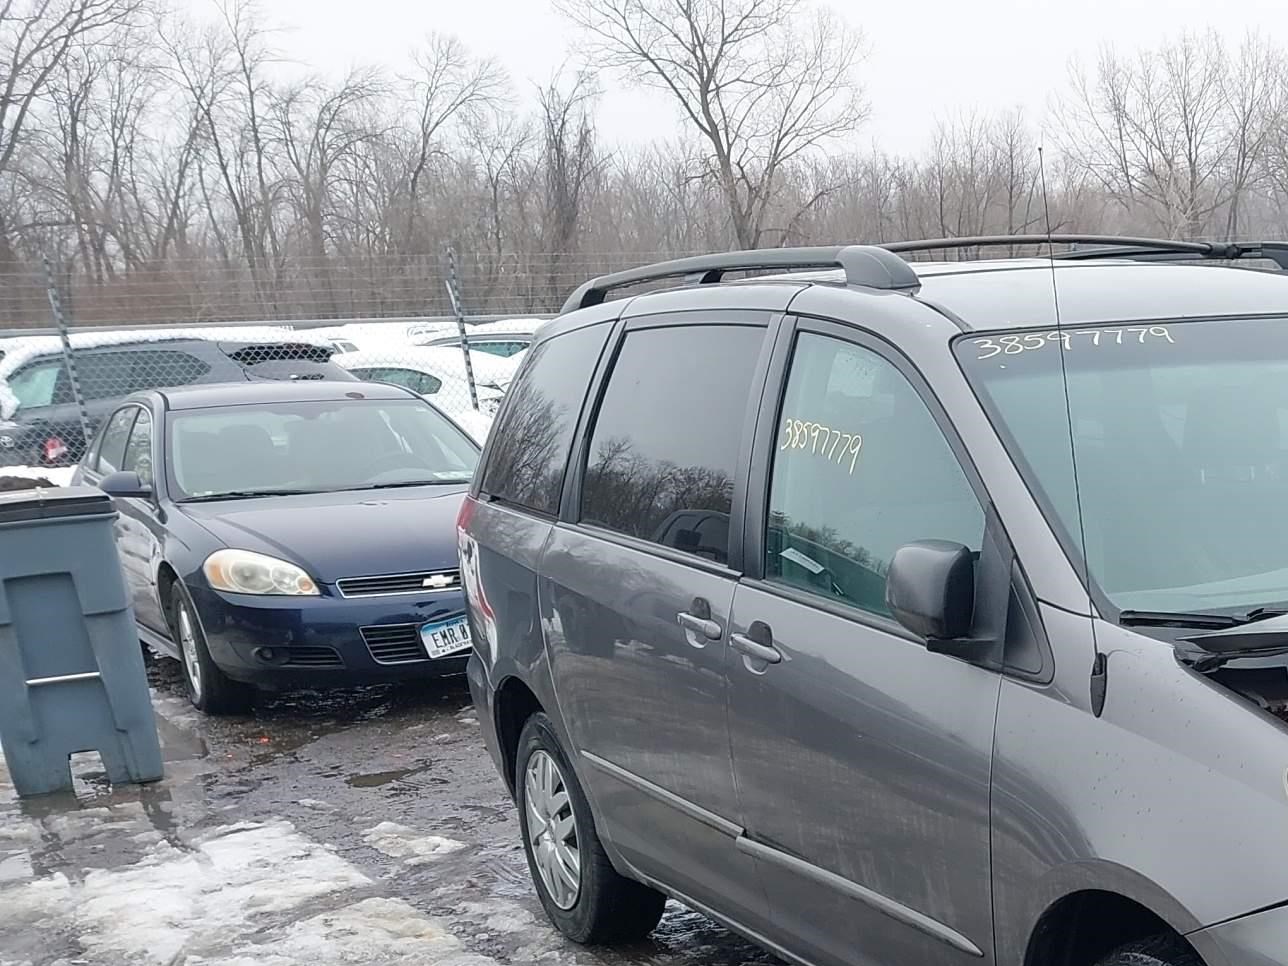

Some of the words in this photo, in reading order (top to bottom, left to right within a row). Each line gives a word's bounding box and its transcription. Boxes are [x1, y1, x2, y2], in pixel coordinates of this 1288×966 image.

[973, 326, 1176, 360] 38597779
[780, 418, 862, 475] 38597779
[431, 627, 458, 649] EMR
